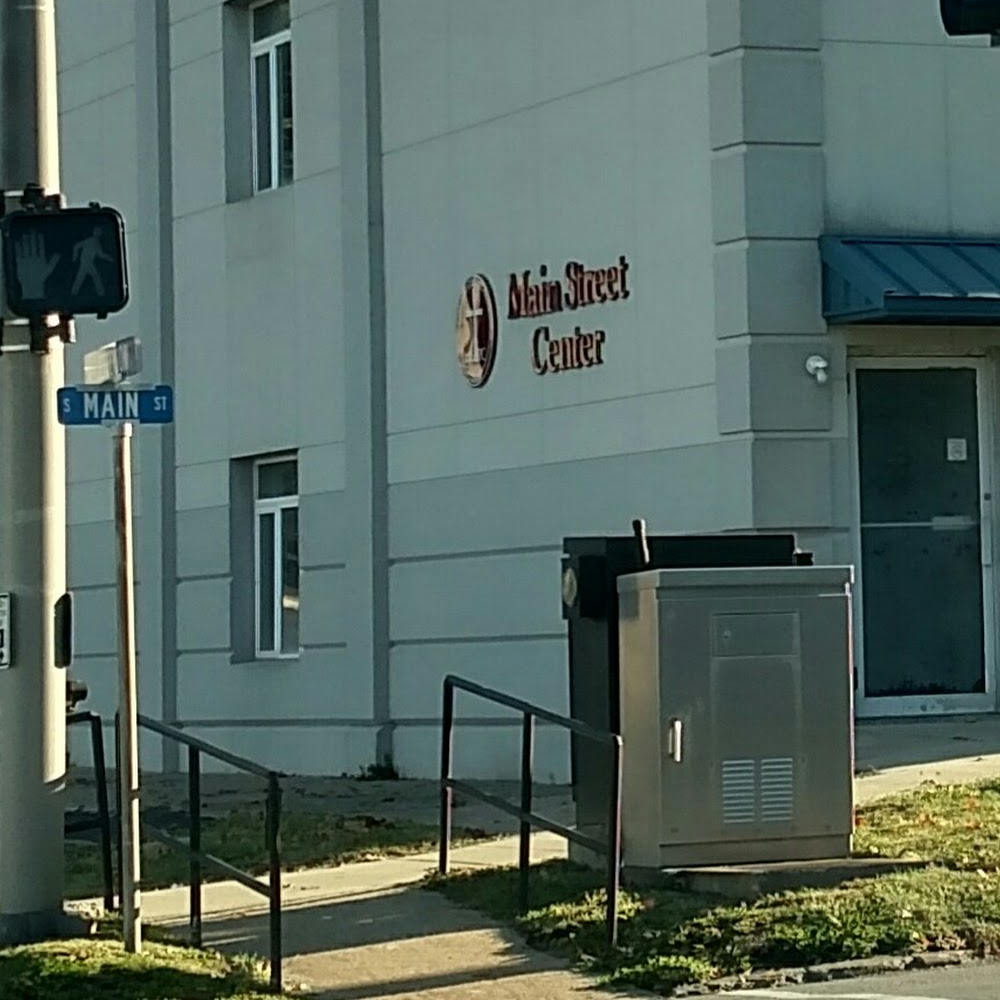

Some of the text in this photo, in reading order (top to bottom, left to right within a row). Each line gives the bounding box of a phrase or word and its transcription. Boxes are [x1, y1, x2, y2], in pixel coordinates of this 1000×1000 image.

[507, 255, 630, 319] Main Street
[532, 326, 606, 375] Center
[64, 391, 167, 419] S MAIN ST
